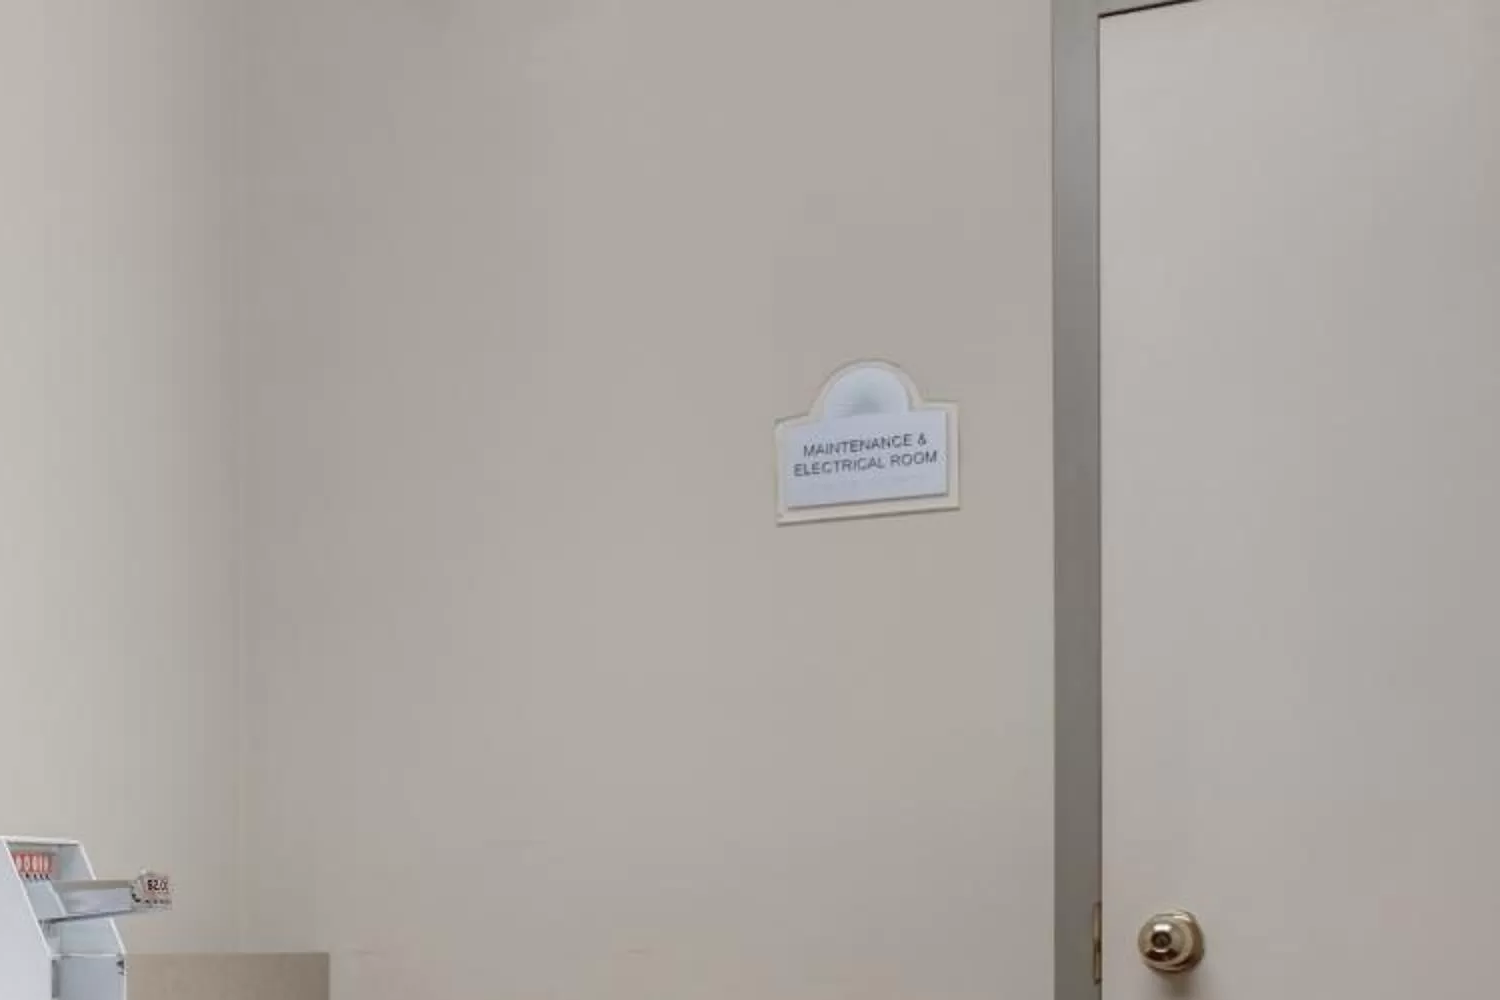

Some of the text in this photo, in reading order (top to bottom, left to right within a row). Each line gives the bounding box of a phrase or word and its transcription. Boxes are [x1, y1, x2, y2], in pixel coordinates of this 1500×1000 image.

[803, 432, 928, 457] MAINTENANCE &
[793, 450, 938, 477] ELECTRICAL ROOM
